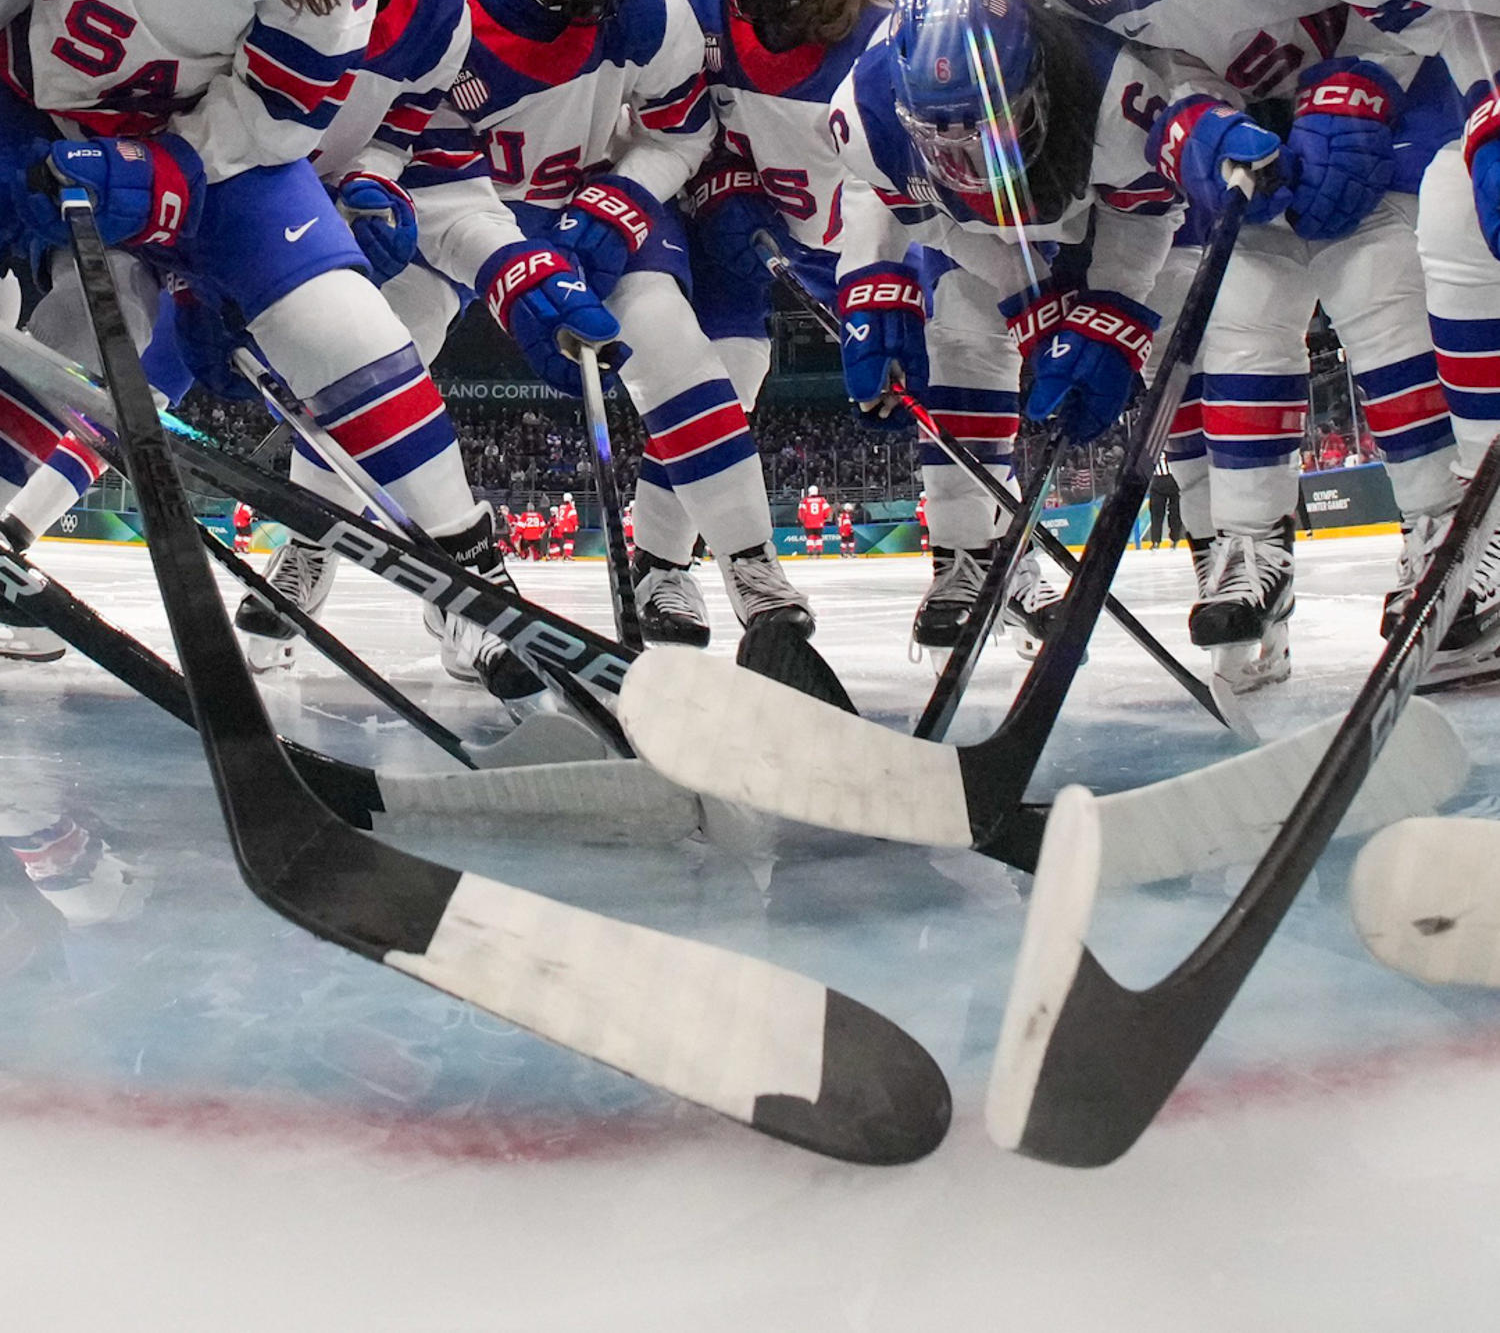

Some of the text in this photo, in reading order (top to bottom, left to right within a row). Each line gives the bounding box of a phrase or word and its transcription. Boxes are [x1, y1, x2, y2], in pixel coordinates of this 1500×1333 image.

[705, 37, 717, 46] SA
[935, 57, 952, 83] 6
[488, 131, 590, 201] US
[576, 186, 649, 250] BAUE
[846, 283, 924, 309] BAU
[1065, 305, 1152, 363] BAUE
[438, 384, 571, 398] LANO CORTIN
[1313, 489, 1339, 501] OLYMPIC
